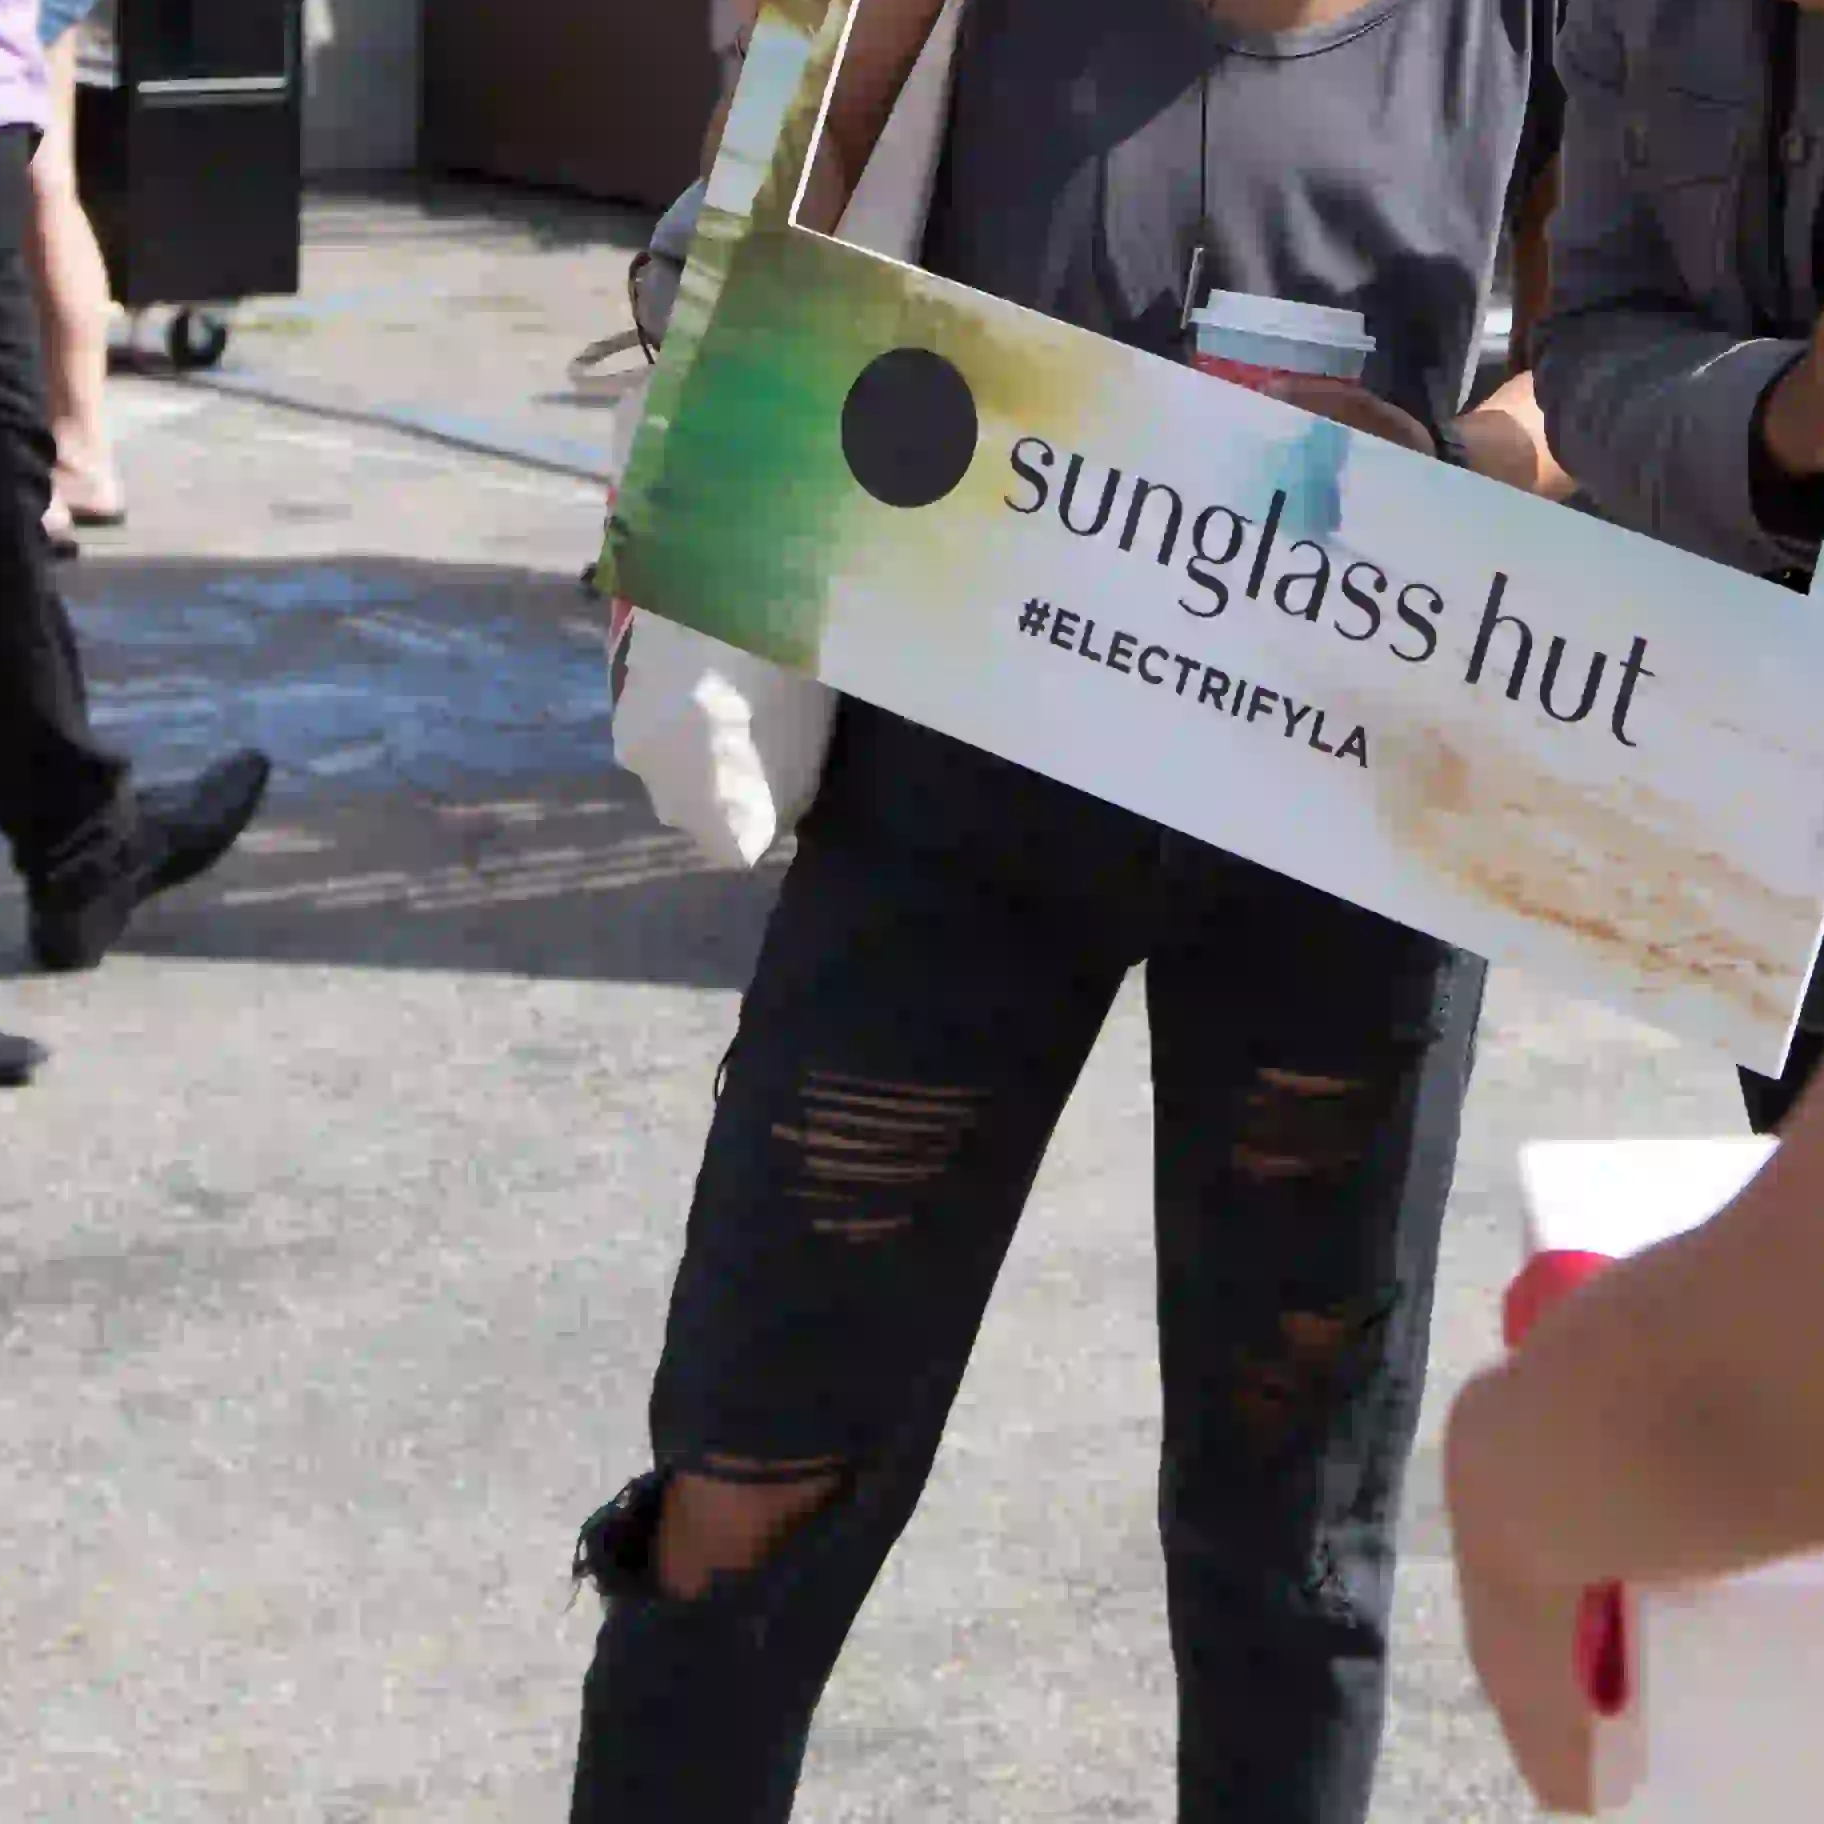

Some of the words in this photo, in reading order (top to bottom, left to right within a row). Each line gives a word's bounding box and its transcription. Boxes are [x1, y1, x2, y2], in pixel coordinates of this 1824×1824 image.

[1004, 437, 1444, 663] sunglass
[1465, 572, 1655, 747] hut
[1019, 598, 1368, 769] #ELECTRIFYLA
